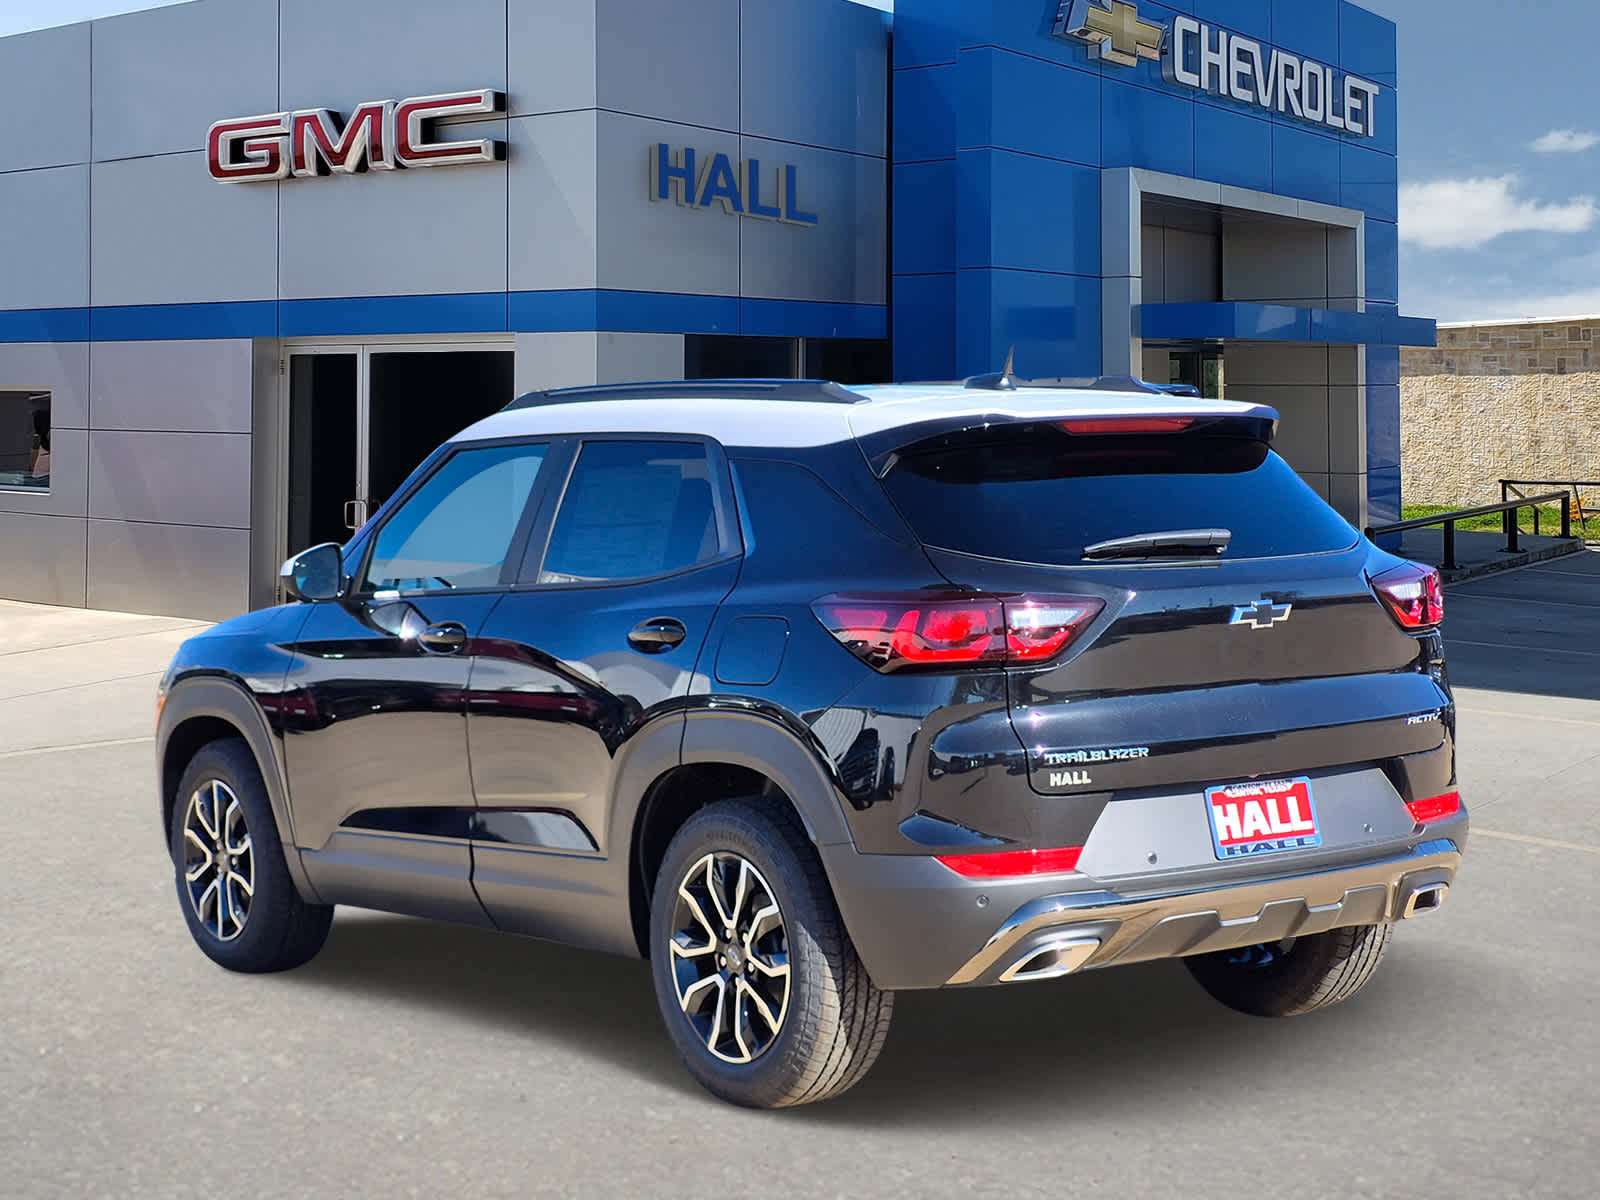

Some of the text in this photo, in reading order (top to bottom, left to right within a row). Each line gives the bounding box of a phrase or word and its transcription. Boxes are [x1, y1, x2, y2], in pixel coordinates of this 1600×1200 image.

[1174, 15, 1380, 137] CHEVROLET
[206, 88, 507, 184] GMC
[650, 143, 818, 226] HALL
[1044, 747, 1150, 764] TRAILBLAZER
[1049, 770, 1092, 787] HALL
[1212, 796, 1313, 841] HALL
[1226, 837, 1316, 856] HALL
